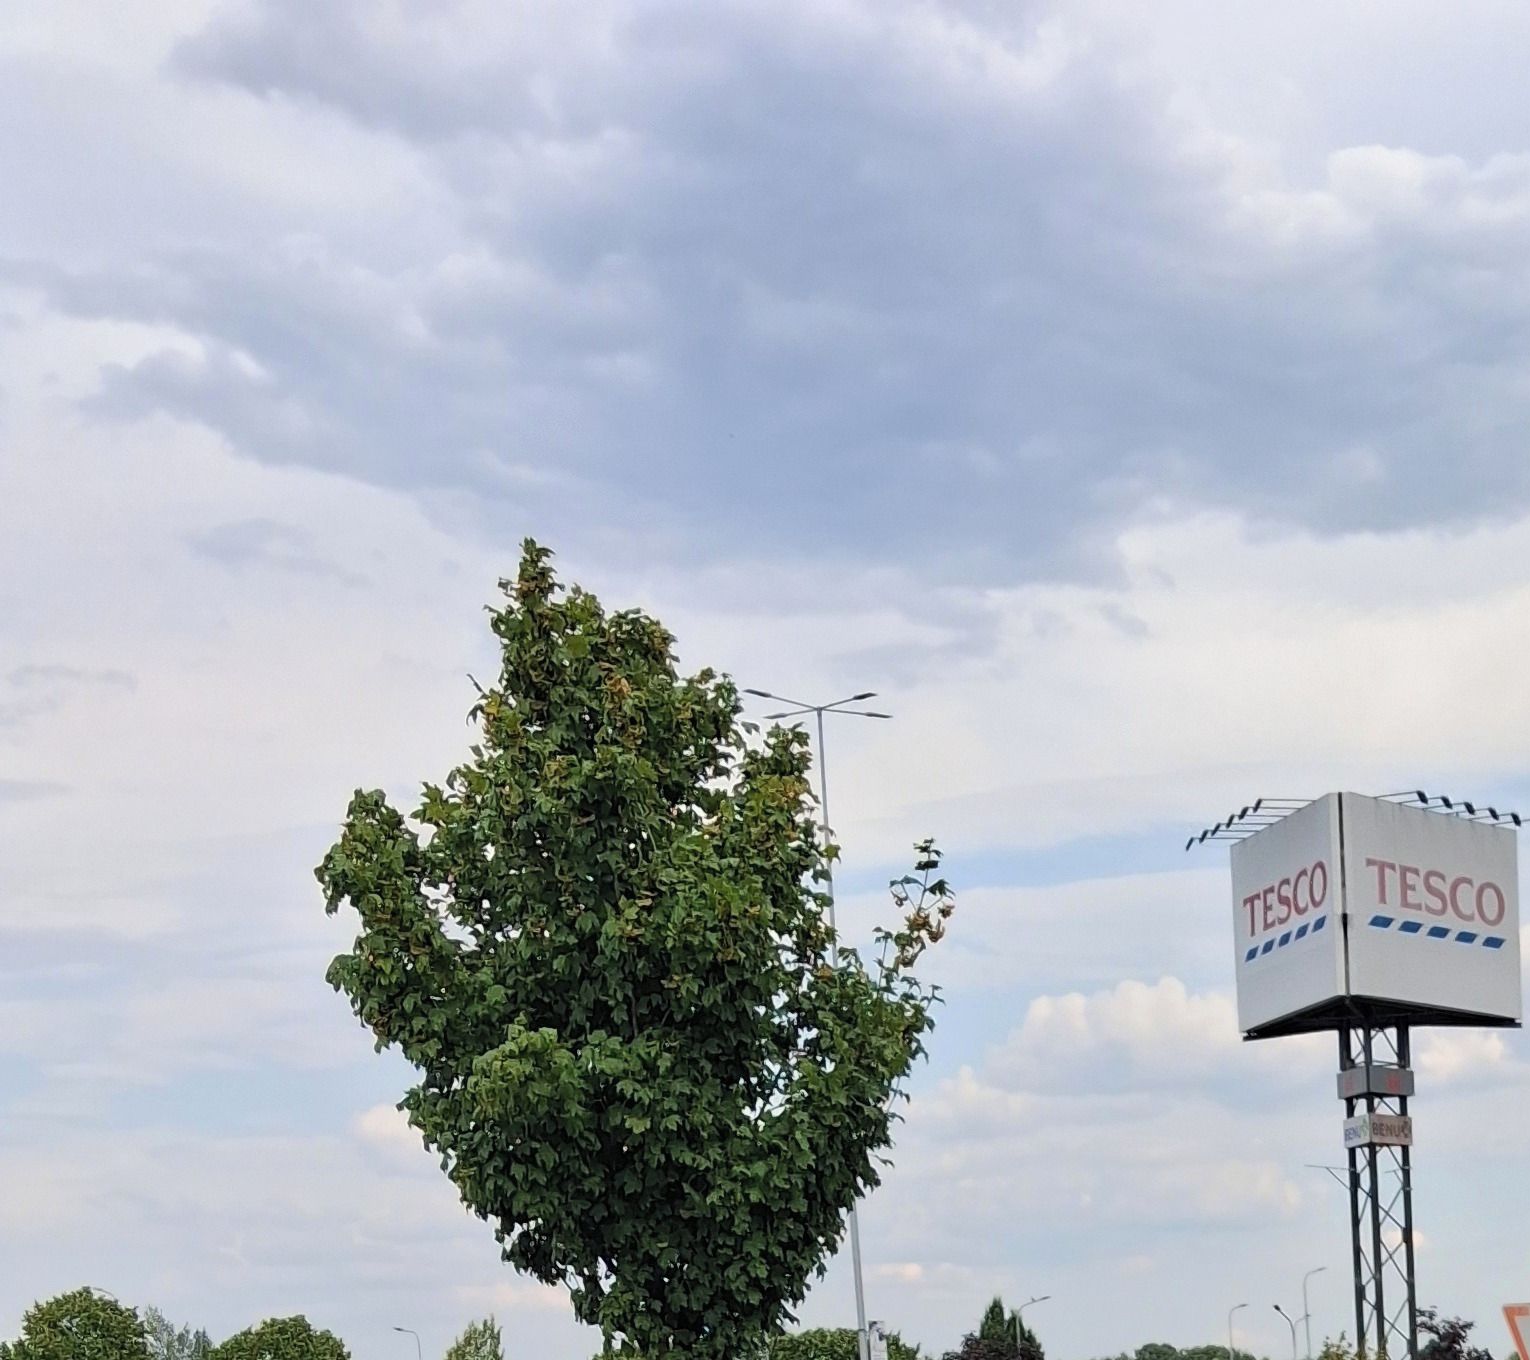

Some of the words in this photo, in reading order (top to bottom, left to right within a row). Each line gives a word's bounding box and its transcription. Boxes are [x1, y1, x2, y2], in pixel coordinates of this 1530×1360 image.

[1243, 860, 1327, 937] TESCO
[1366, 857, 1505, 927] TESCO
[1372, 1121, 1400, 1138] BENU
